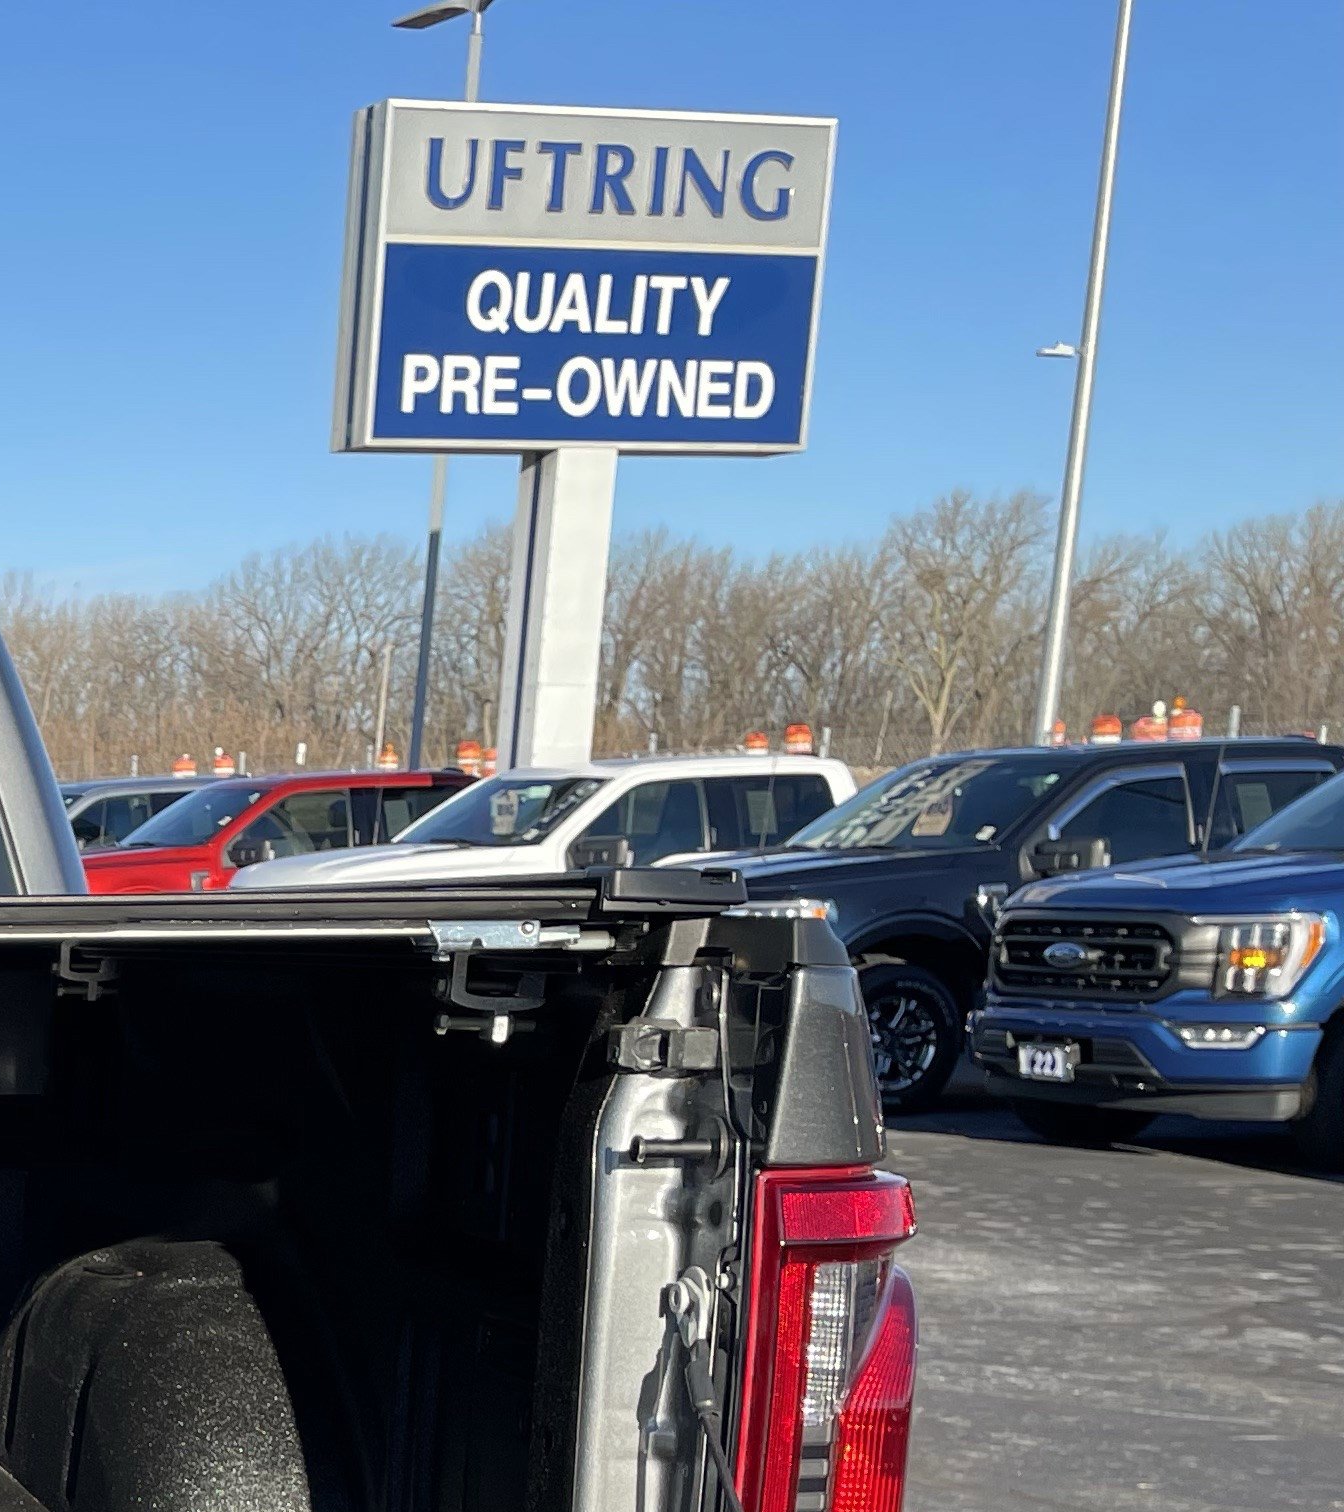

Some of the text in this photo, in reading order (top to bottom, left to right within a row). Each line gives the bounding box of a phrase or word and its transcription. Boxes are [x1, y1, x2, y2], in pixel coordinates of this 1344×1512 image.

[425, 136, 796, 222] UFTRING
[465, 268, 732, 337] QUALITY
[399, 353, 776, 420] PRE-OWNED
